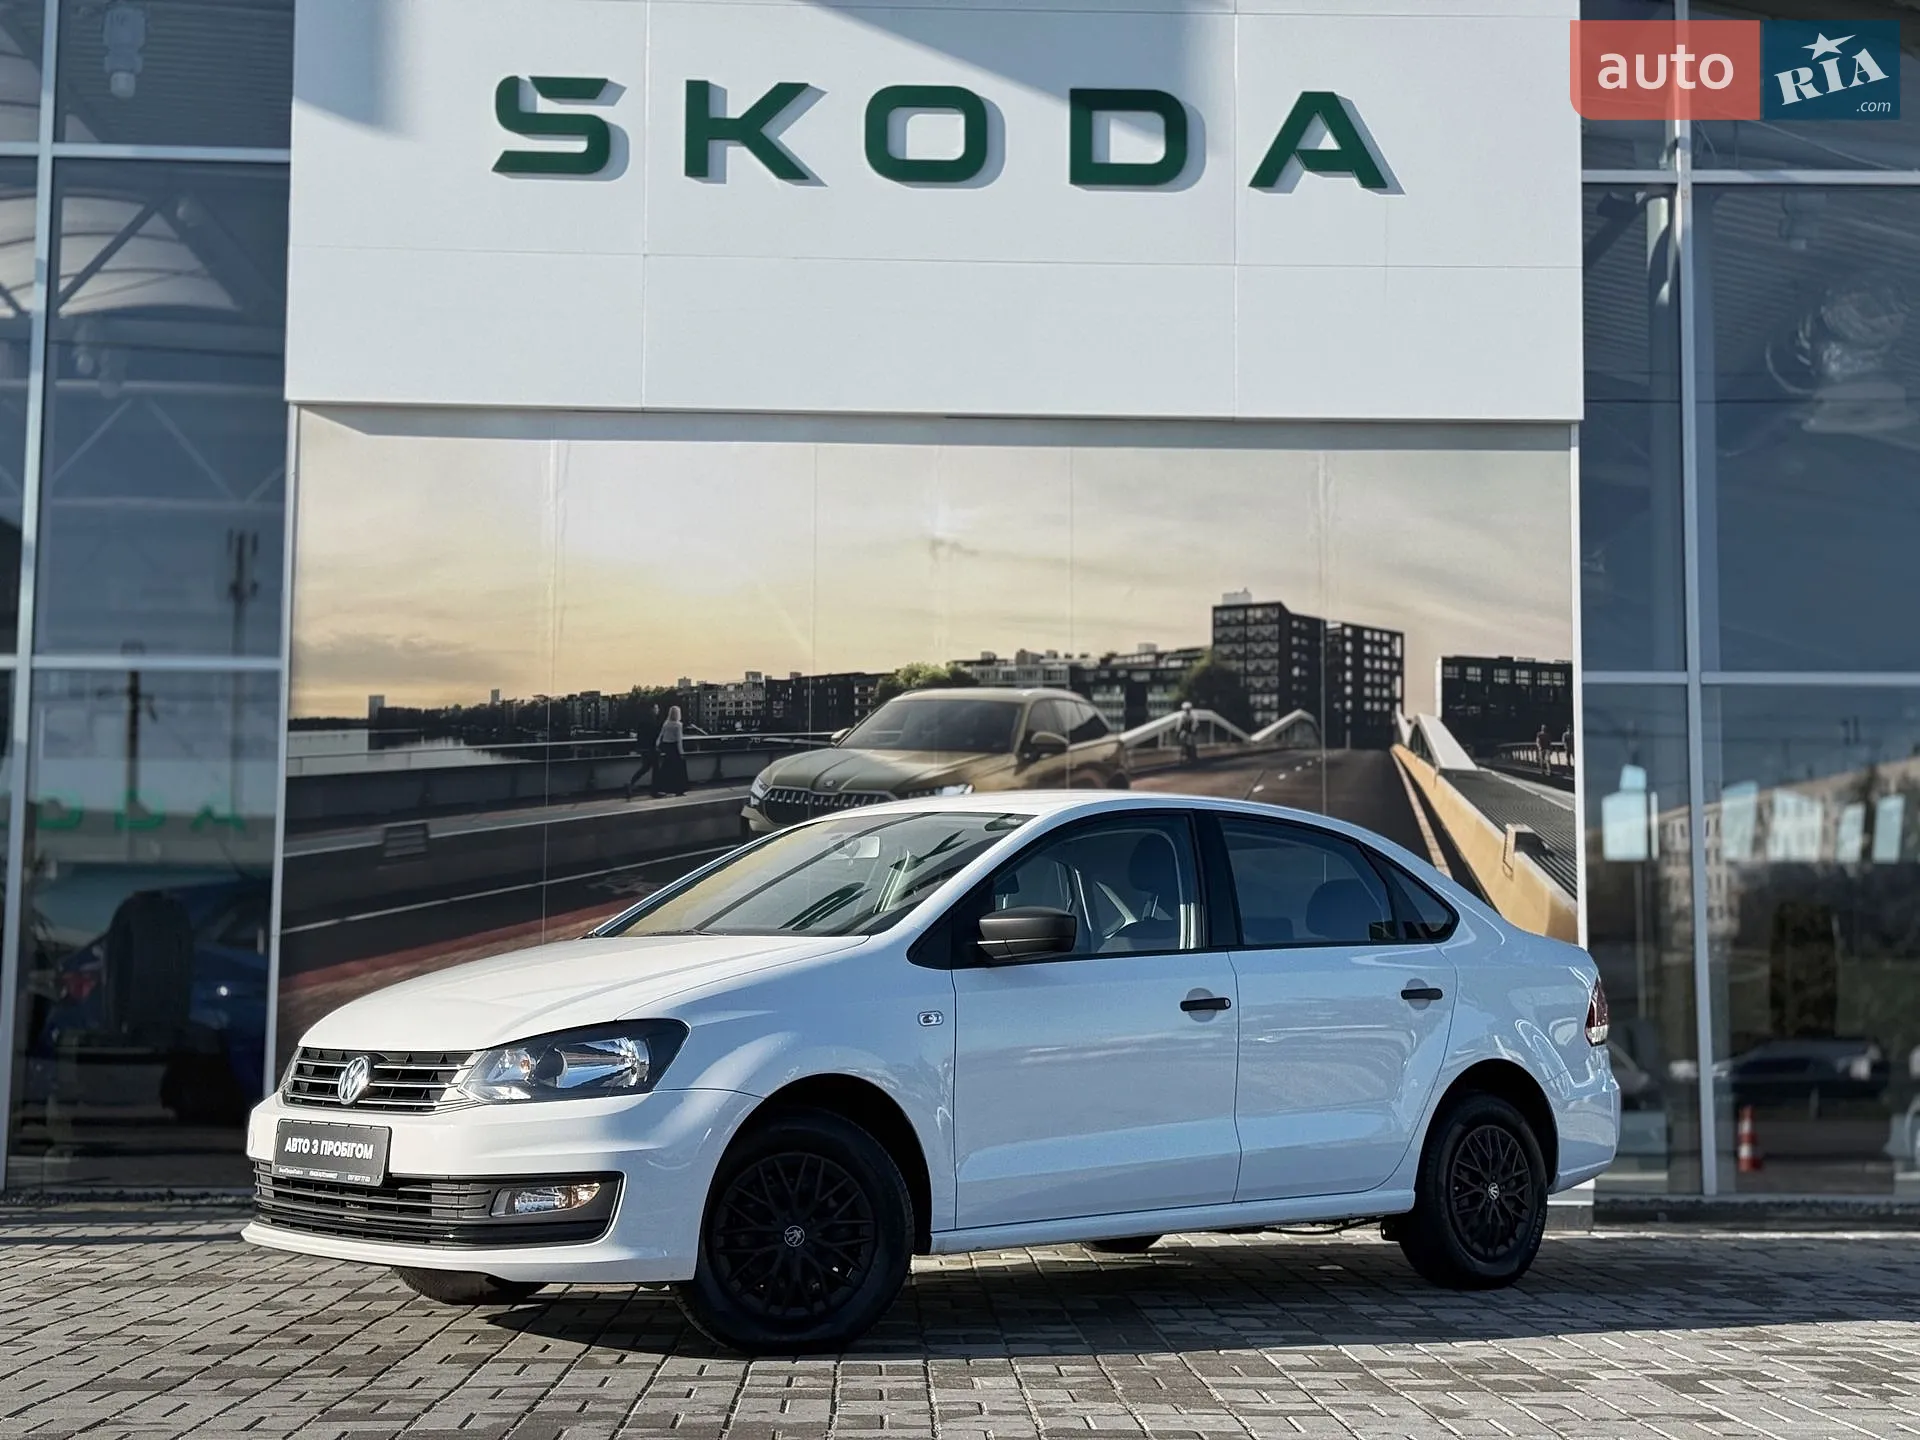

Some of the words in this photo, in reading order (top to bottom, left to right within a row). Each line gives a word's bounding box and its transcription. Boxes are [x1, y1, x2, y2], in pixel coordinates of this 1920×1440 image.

[491, 75, 1388, 190] SKODA
[285, 1137, 310, 1154] АВТО
[320, 1140, 375, 1160] ПРОБІГОМ
